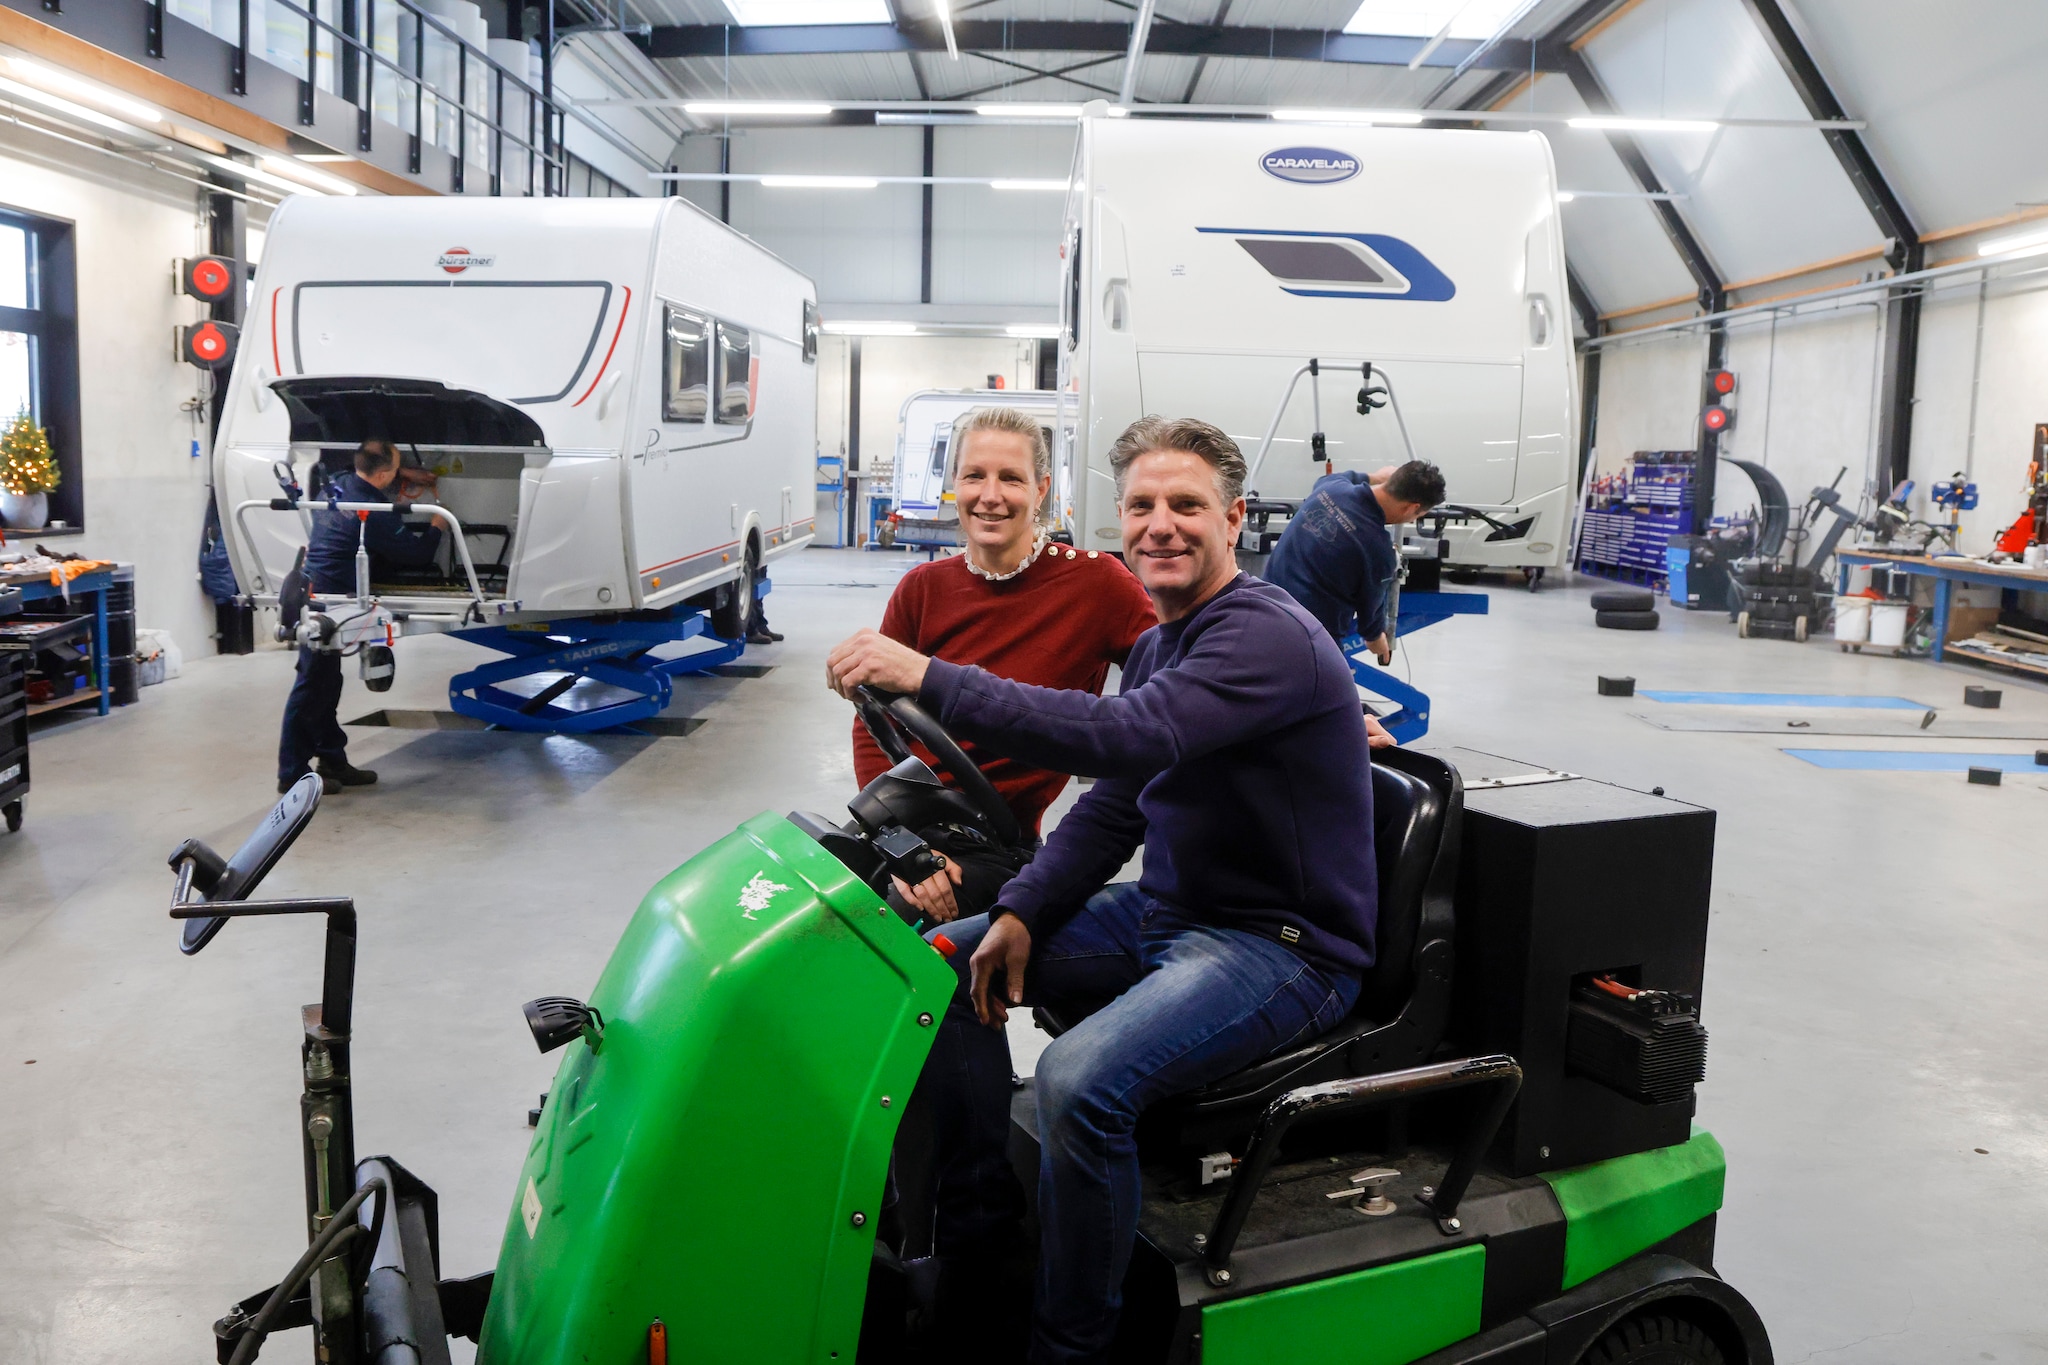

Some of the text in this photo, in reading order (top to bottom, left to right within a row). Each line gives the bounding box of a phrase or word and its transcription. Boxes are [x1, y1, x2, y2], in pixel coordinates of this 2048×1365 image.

[1265, 158, 1355, 169] CARAVELAIR
[438, 255, 492, 265] bürstner
[572, 642, 618, 661] AUTEC
